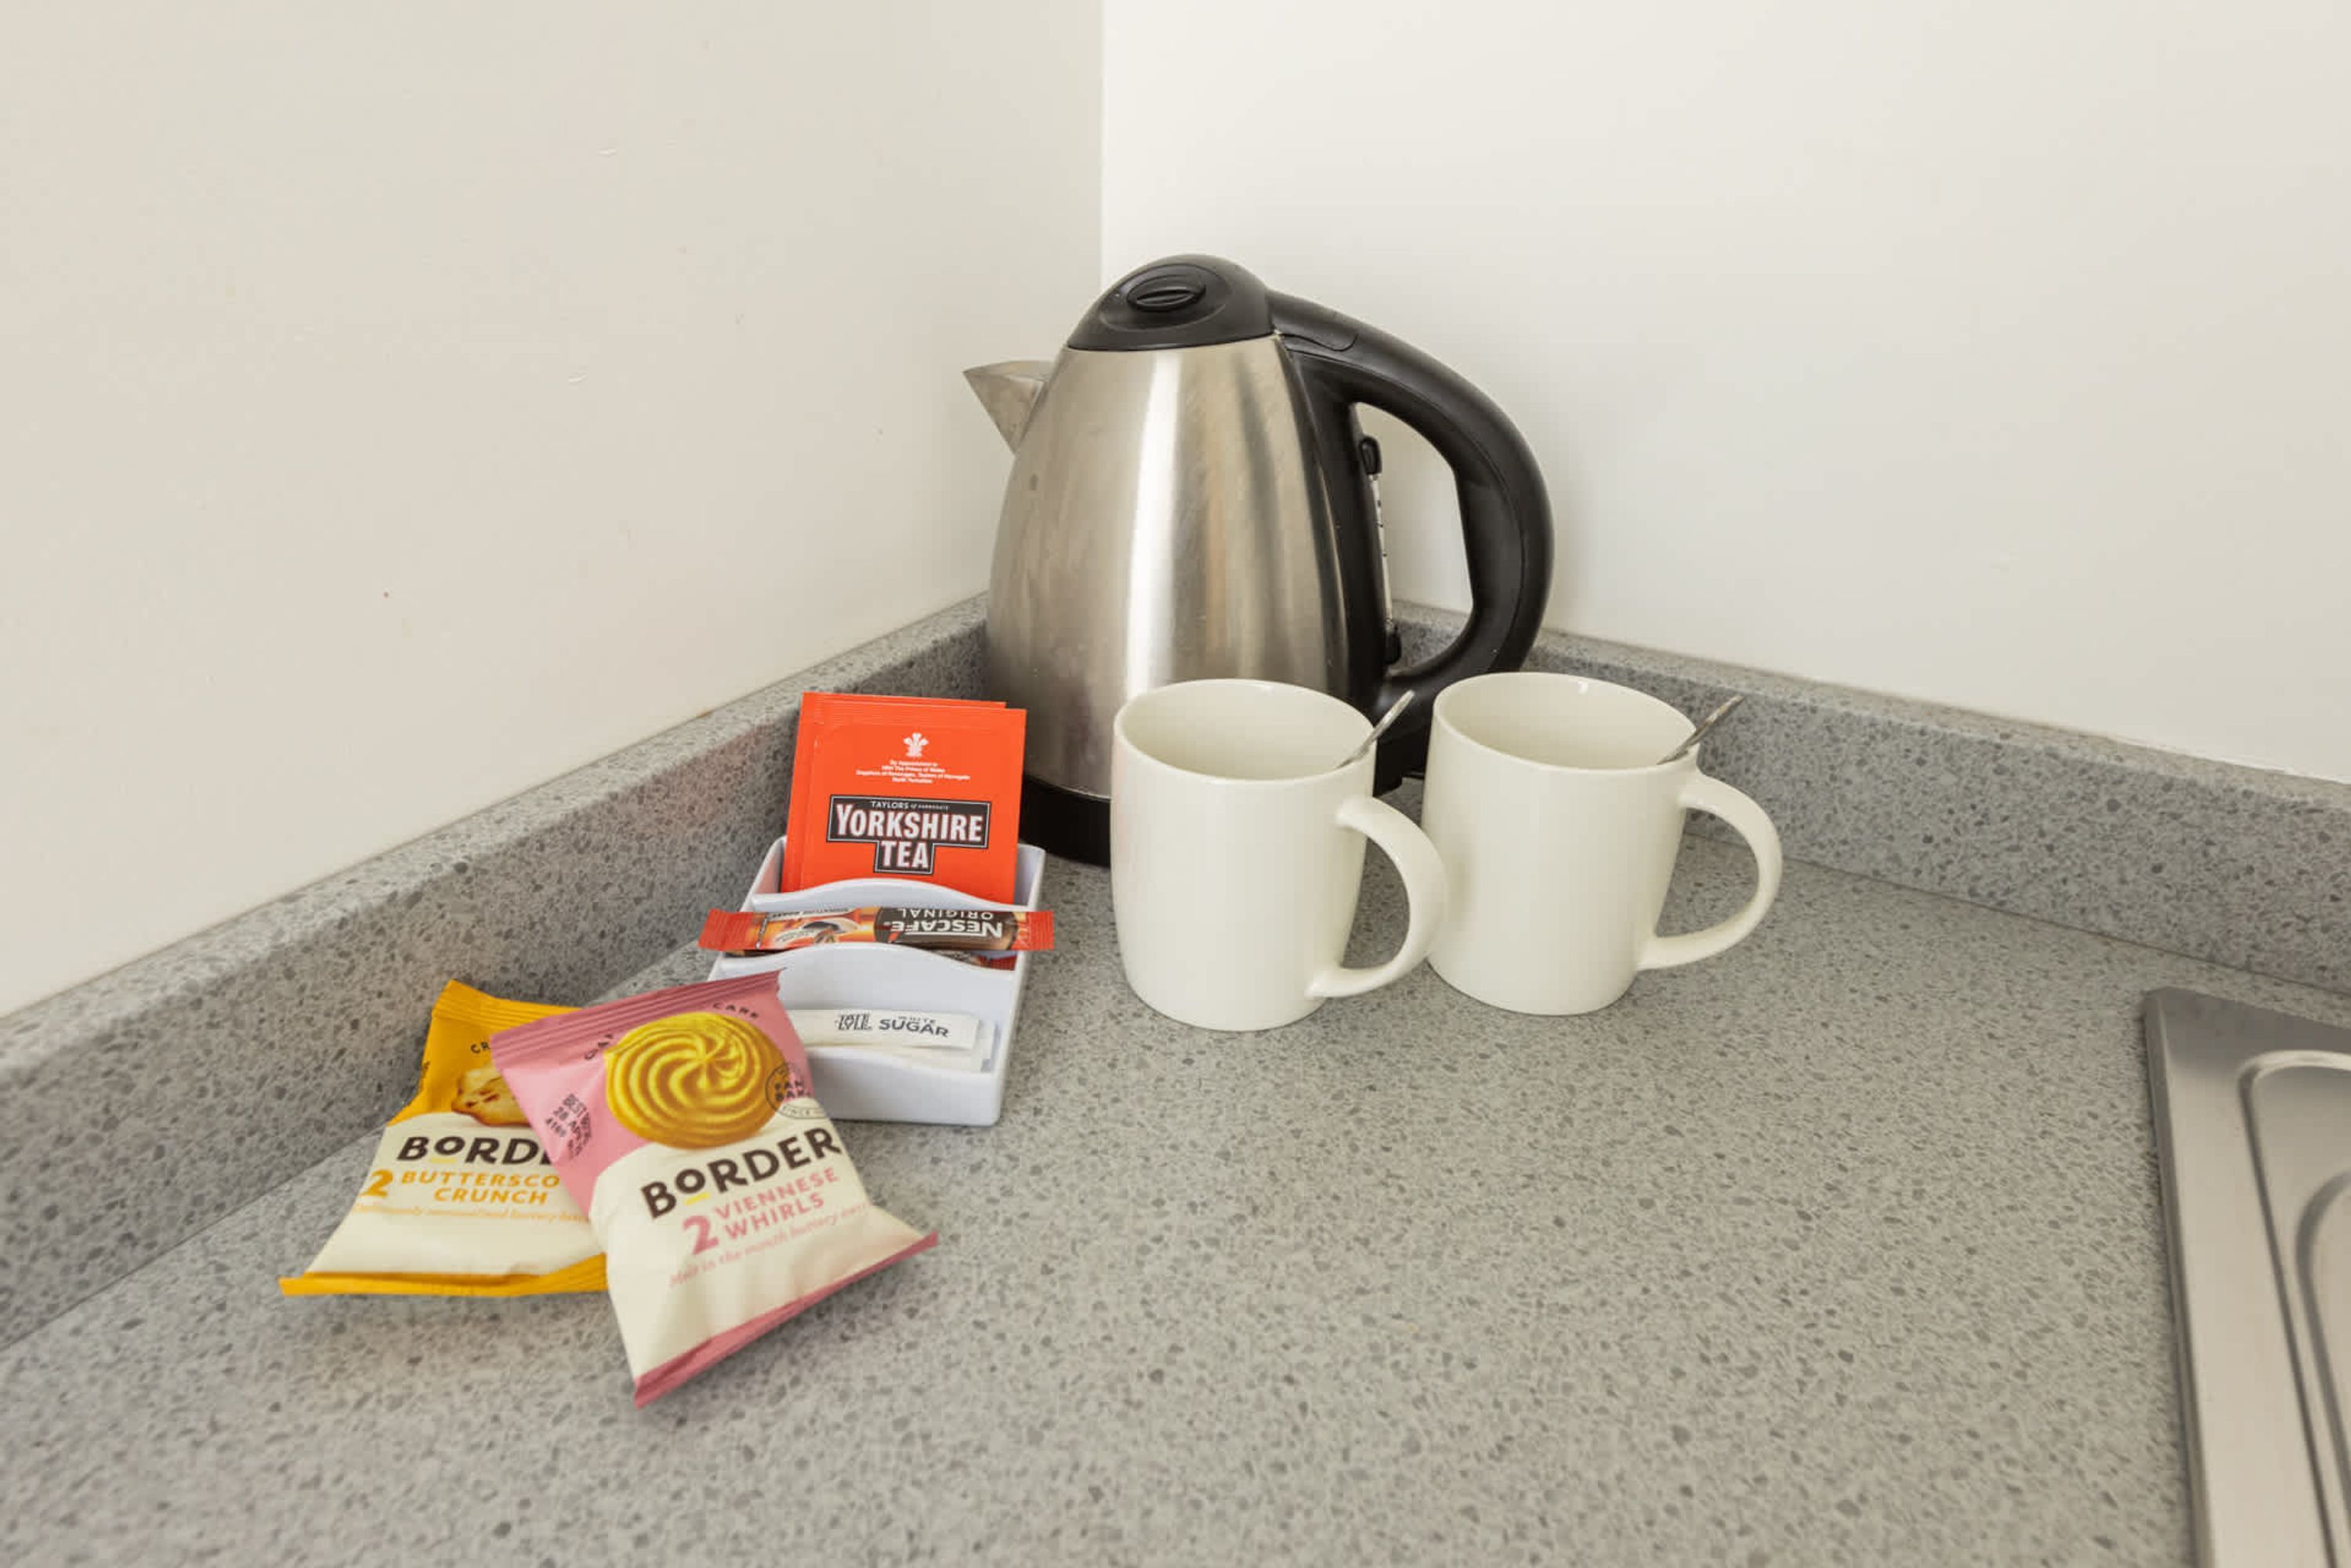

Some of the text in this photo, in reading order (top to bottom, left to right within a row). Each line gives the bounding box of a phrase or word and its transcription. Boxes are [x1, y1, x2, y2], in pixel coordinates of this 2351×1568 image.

[871, 801, 909, 810] TAYLORS
[835, 803, 984, 842] YORKSHIRE
[881, 840, 929, 868] TEA
[899, 909, 994, 920] ORIGINAL
[878, 1019, 950, 1037] SUGAR
[397, 1136, 552, 1165] BORD
[360, 1169, 560, 1197] 2 BUTTERSCO
[641, 1128, 842, 1219] BORDER
[433, 1187, 547, 1204] CRUNCH
[682, 1167, 840, 1255] 2 VIENNESE
[723, 1192, 825, 1240] WHIRLS
